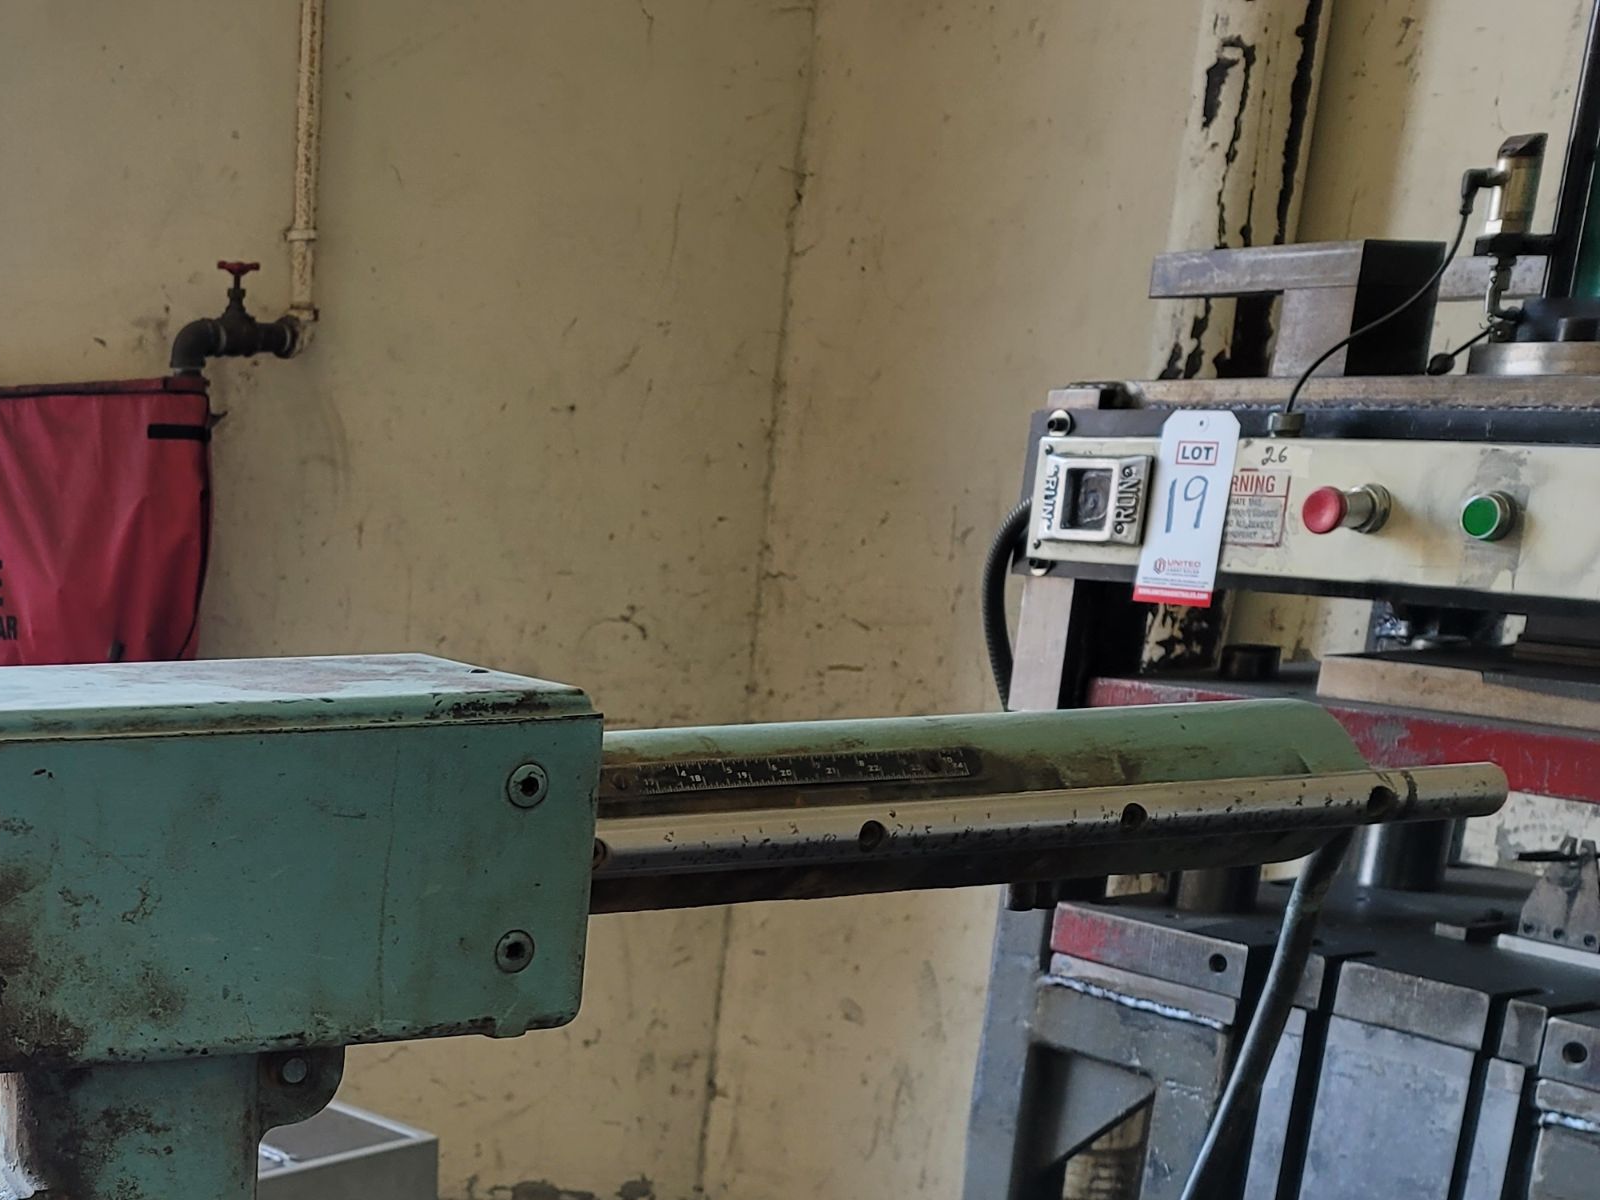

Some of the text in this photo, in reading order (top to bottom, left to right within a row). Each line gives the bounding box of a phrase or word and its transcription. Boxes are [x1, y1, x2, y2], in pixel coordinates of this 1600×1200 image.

[1181, 445, 1214, 461] LOT
[1261, 446, 1288, 466] 26
[1232, 475, 1276, 493] RNING
[1116, 479, 1141, 523] RUN
[1165, 475, 1209, 534] 19
